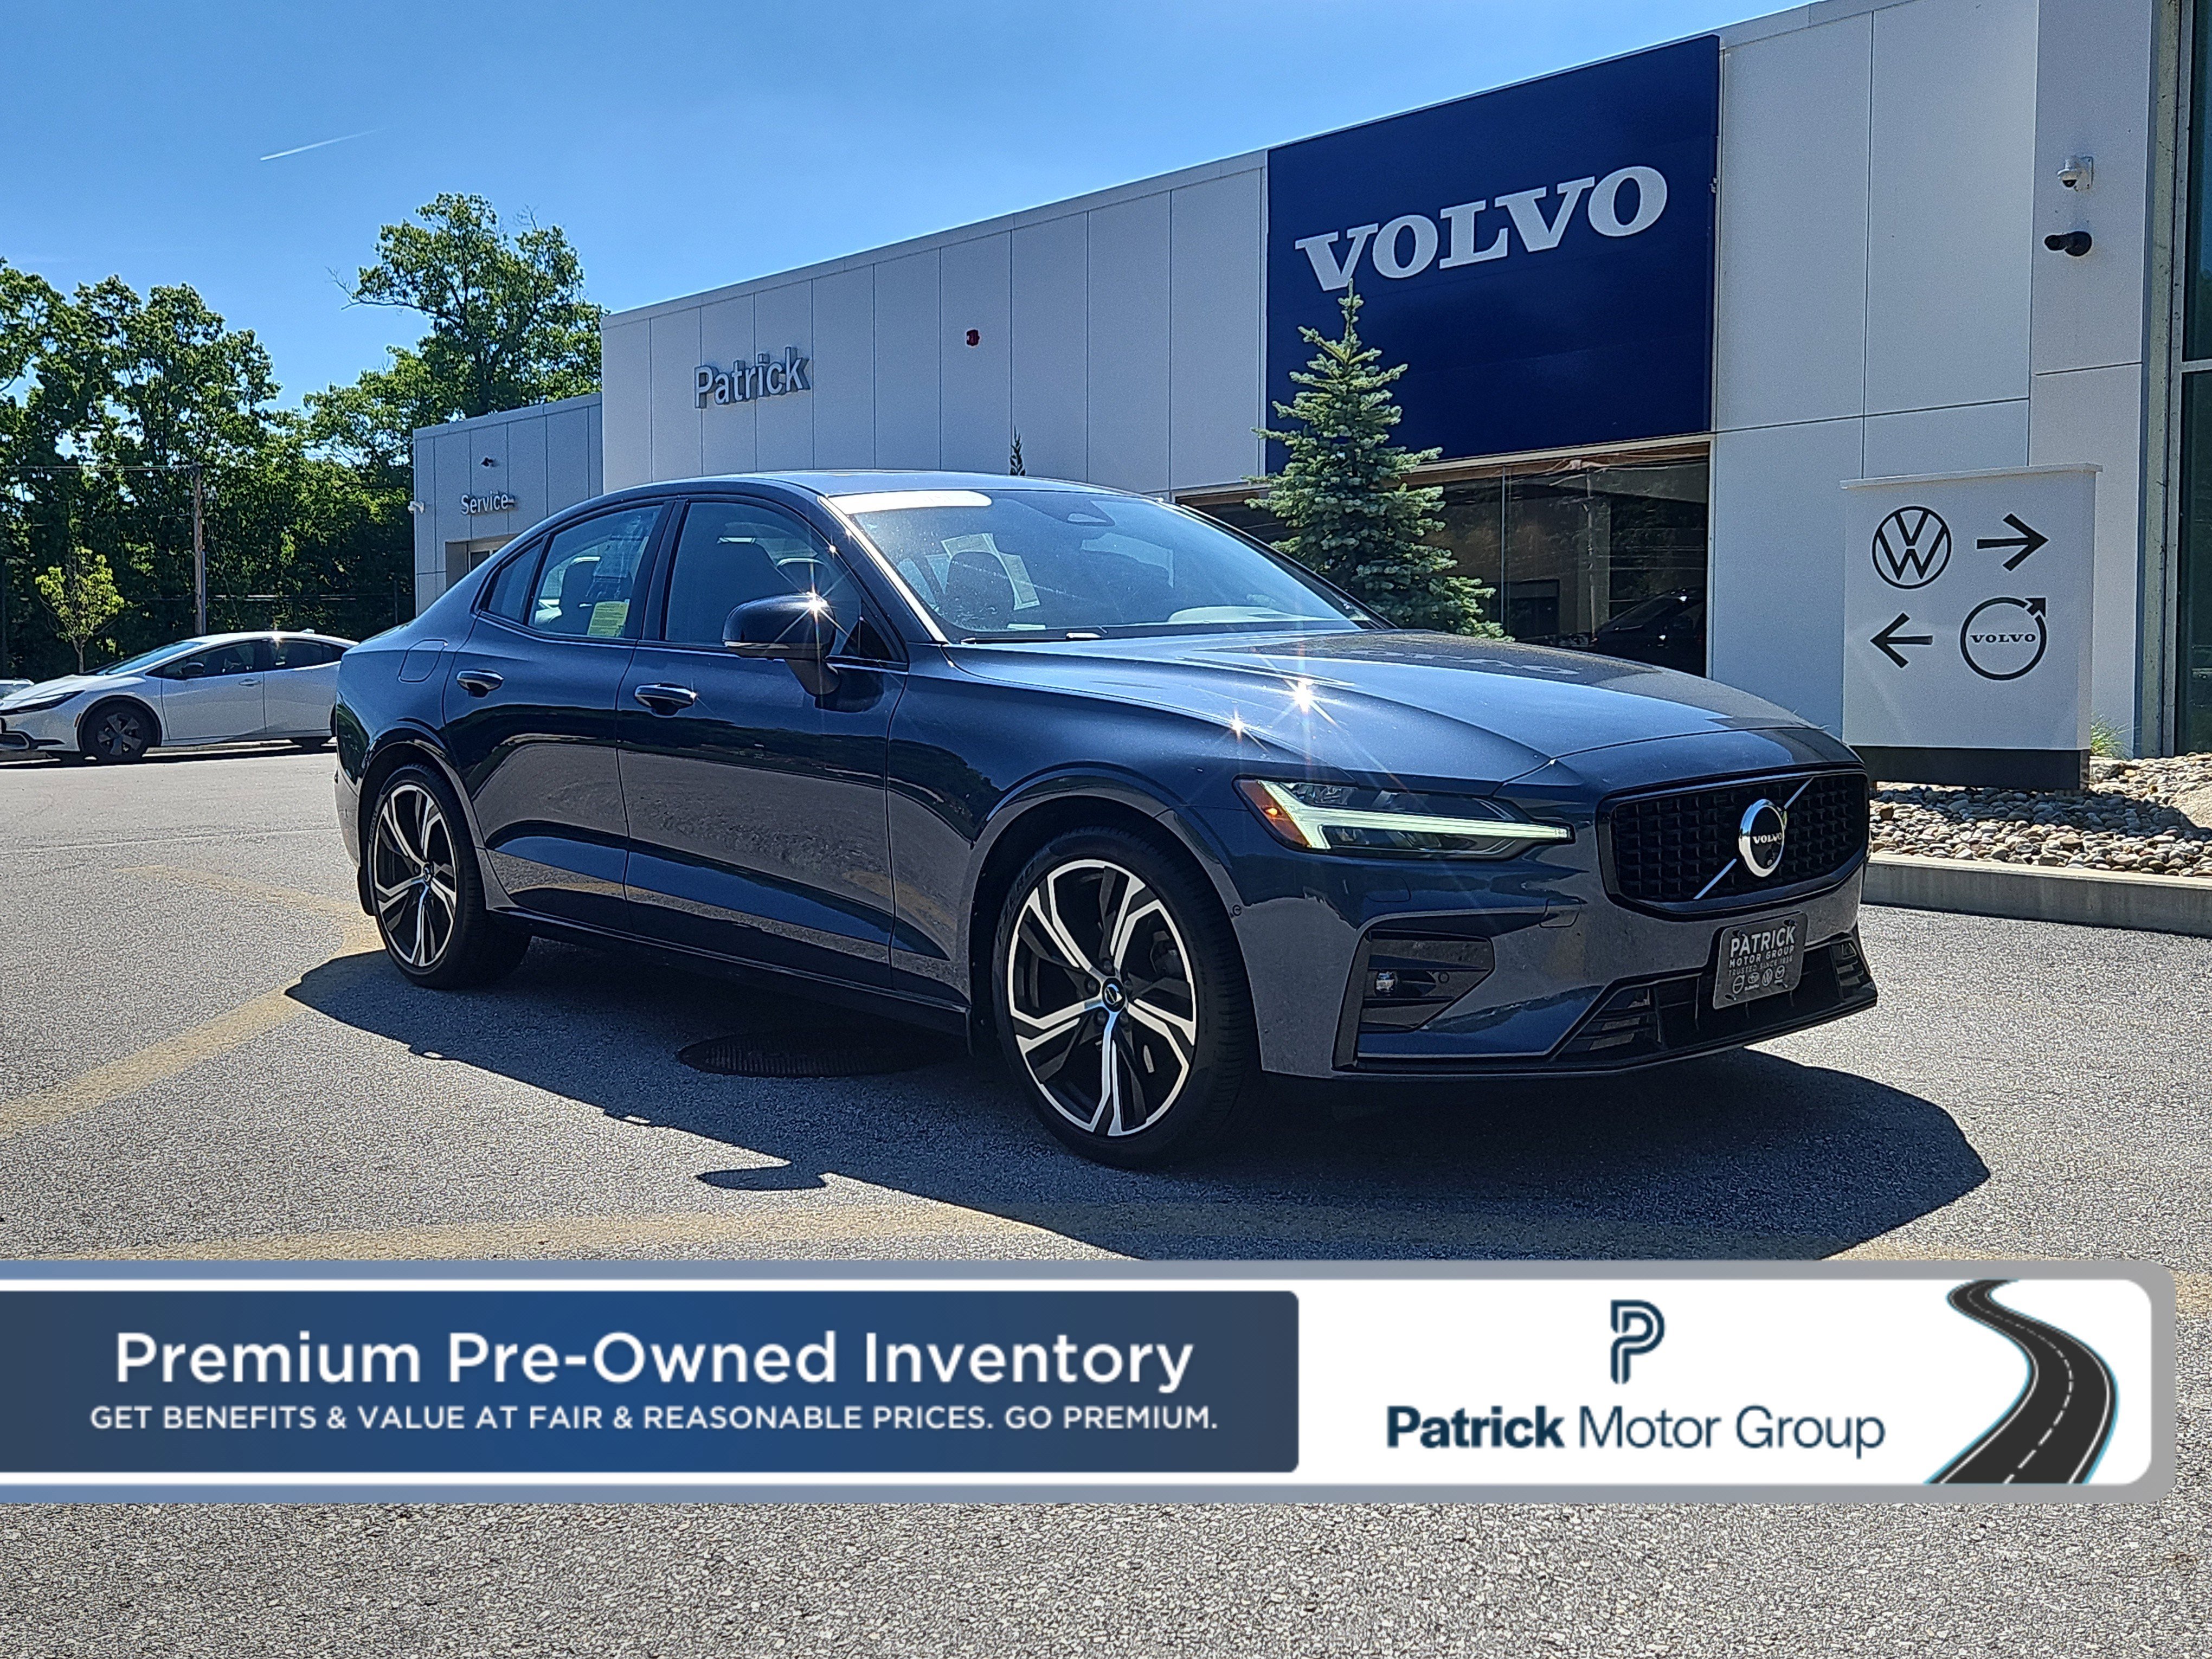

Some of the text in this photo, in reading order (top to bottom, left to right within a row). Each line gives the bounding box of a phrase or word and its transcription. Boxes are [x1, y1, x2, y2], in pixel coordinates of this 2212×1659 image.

[1295, 166, 1668, 292] VOLVO
[695, 345, 808, 408] Patrick
[461, 490, 510, 515] Service
[1970, 633, 2036, 644] VOLVO
[1752, 832, 1782, 844] VOLVO
[1730, 926, 1796, 958] PATRICK
[1729, 945, 1795, 969] MOTOR GROUP
